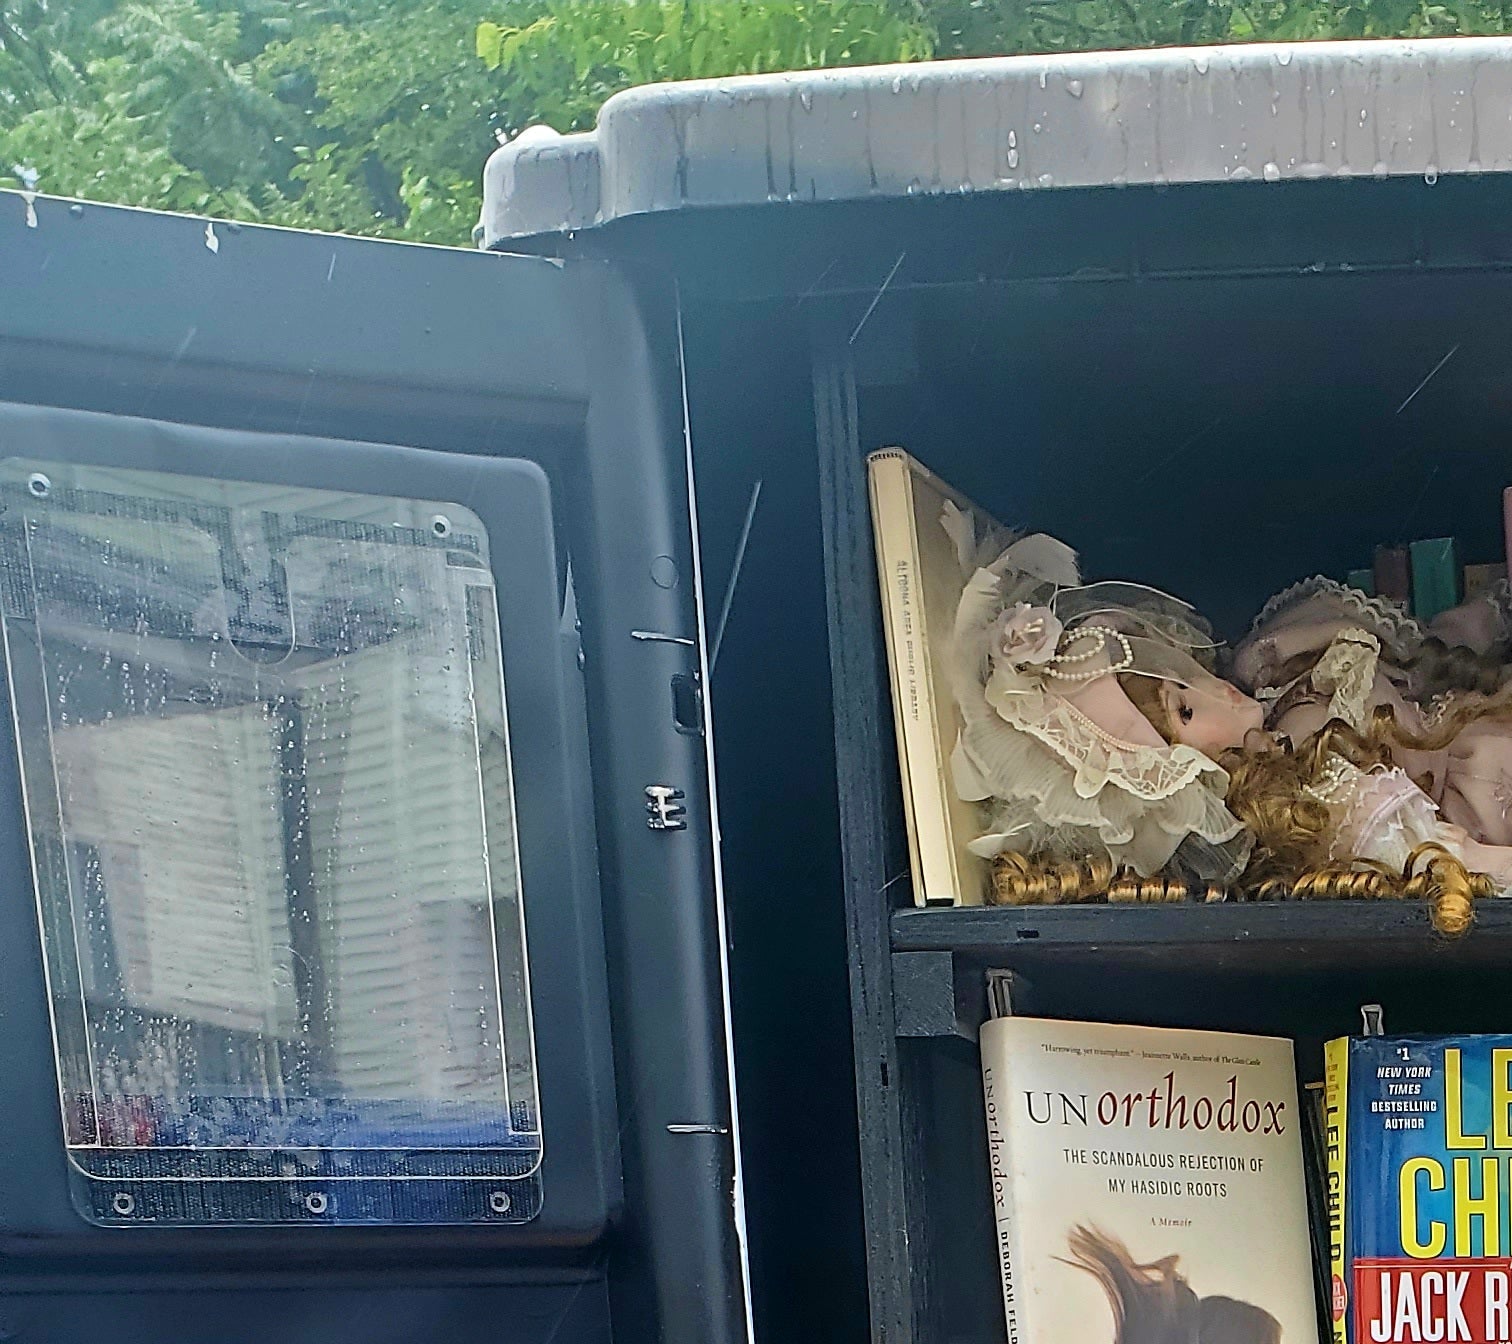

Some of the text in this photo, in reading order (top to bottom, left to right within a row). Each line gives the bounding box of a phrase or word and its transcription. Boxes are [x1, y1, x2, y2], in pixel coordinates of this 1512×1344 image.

[1377, 1067, 1432, 1078] NEW YORK
[1388, 1084, 1421, 1095] TIMES
[1371, 1101, 1437, 1112] BESTSELLING
[1327, 1107, 1339, 1161] LEE
[1385, 1118, 1425, 1130] AUTHOR
[1064, 1149, 1264, 1172] THE SCANDALOUS REJECTION OF
[1109, 1179, 1227, 1197] MY HASIDIC ROOTS
[1327, 1169, 1341, 1262] CHILD
[1000, 1230, 1015, 1304] DEBORAH
[1371, 1270, 1471, 1343] JACK
